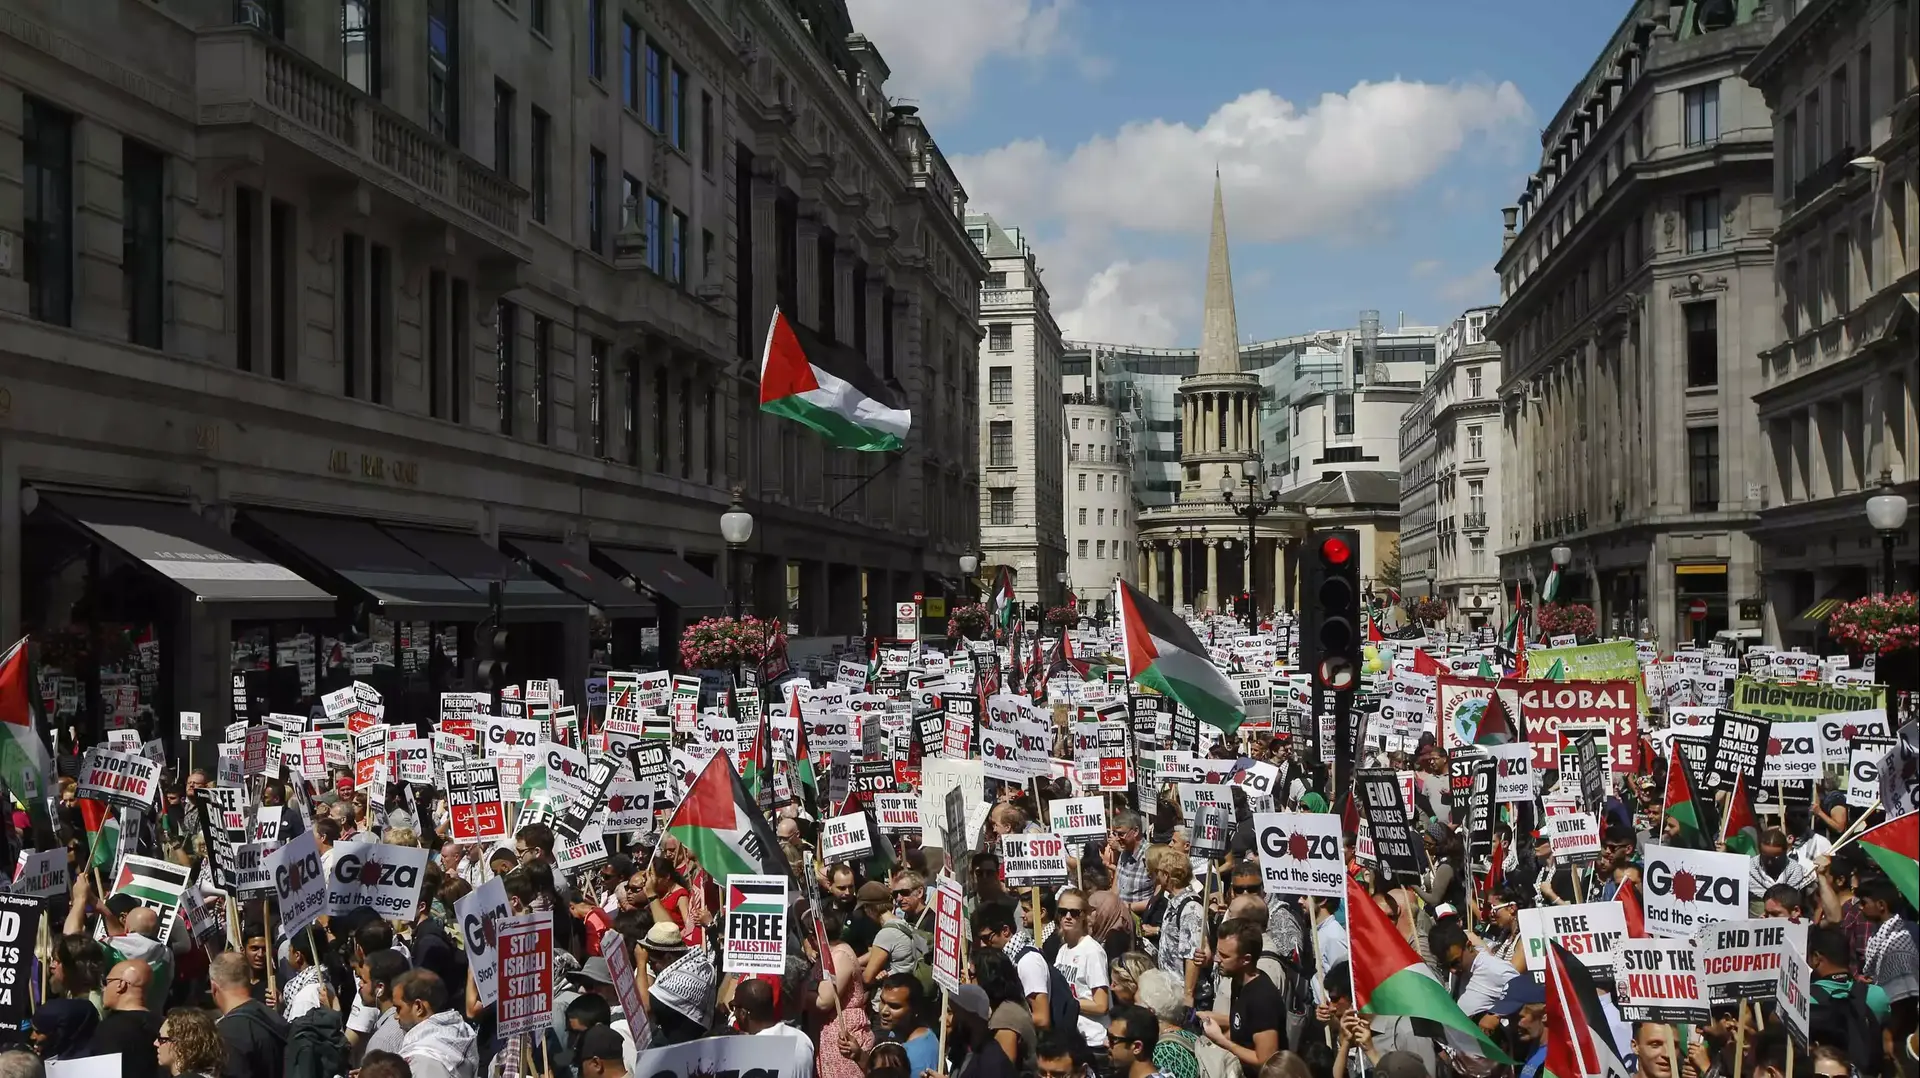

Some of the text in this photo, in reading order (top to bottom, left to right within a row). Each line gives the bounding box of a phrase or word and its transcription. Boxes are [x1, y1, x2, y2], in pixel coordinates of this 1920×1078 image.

[1237, 640, 1262, 650] Gza
[1551, 637, 1576, 647] Gza
[888, 652, 908, 665] Gza
[923, 656, 944, 667] Gza
[1675, 654, 1702, 664] Gza
[1774, 655, 1805, 666] Gza
[839, 667, 866, 682] Gza
[1835, 674, 1872, 686] Gza
[1240, 680, 1260, 691] END
[1394, 681, 1428, 699] Gza
[1239, 689, 1266, 699] SRAELI
[1523, 689, 1631, 709] GLOBAL
[1742, 684, 1877, 711] International
[444, 699, 473, 711] FREEDOM
[850, 700, 887, 713] Gza
[949, 700, 972, 714] END
[1136, 699, 1157, 710] END
[1444, 689, 1483, 721] INVEST IN
[611, 710, 638, 723] FREE
[991, 705, 1018, 724] Gza
[1380, 705, 1424, 724] Gza
[1672, 712, 1716, 728] Gza
[605, 719, 641, 734] PALESTINE
[704, 725, 735, 744] Gza
[803, 721, 847, 737] Gza
[920, 718, 942, 736] END
[950, 723, 964, 735] STOP
[1722, 719, 1760, 742] END
[1822, 722, 1885, 742] Gza
[489, 723, 536, 747] Gza
[1015, 729, 1045, 752] Gza
[815, 738, 849, 750] the siege
[1718, 737, 1760, 755] ISRAEL'S
[1826, 746, 1843, 757] End
[548, 750, 588, 780] Gza
[641, 748, 665, 770] END
[1163, 754, 1178, 763] FREE
[1715, 751, 1757, 767] ATTACKS
[94, 754, 152, 781] STOP THE
[1156, 763, 1191, 774] ALESTINE
[1714, 763, 1728, 774] ON
[1784, 761, 1817, 775] siege
[89, 769, 147, 796] KILLING
[450, 769, 494, 785] FREEDOM
[1195, 790, 1214, 802] FREE
[1365, 782, 1395, 807] END
[1499, 781, 1530, 795] the siege
[1851, 787, 1872, 799] End
[450, 788, 499, 805] PALESTINE
[881, 796, 918, 809] STOP THE
[884, 811, 919, 824] KILLING
[1066, 804, 1084, 815] FREE
[1371, 808, 1403, 825] ISRAEL'S
[608, 815, 648, 829] the siege
[1053, 814, 1103, 829] PALESTINE
[1571, 820, 1586, 834] THE
[826, 824, 847, 839] FREE
[1375, 825, 1408, 841] ATTACKS
[1261, 824, 1341, 863] Gza
[1380, 842, 1412, 857] ON GAZA
[1551, 834, 1598, 851] OCCUPATION
[557, 839, 603, 863] PALESTINE
[1006, 840, 1062, 862] UK: STOP
[276, 850, 321, 900] Gza
[335, 853, 418, 888] Gza
[1006, 862, 1065, 876] ARMING ISRAEL
[237, 870, 271, 885] ARMING
[1266, 867, 1343, 888] End the siege
[1646, 861, 1740, 906] Gza
[9, 897, 39, 906] Campaign
[329, 891, 411, 909] End the siege
[1647, 904, 1669, 922] End
[1671, 908, 1693, 926] the
[729, 913, 783, 941] FREE
[1554, 915, 1589, 934] FREE
[510, 932, 539, 955] STOP
[728, 940, 783, 953] PALESTINE
[1717, 927, 1785, 950] END THE
[503, 952, 546, 978] ISRAELI
[1624, 950, 1696, 971] STOP THE
[508, 973, 542, 998] STATE
[1628, 973, 1699, 1000] KILLING
[502, 993, 547, 1020] TERROR
[1623, 1007, 1640, 1020] FOA
